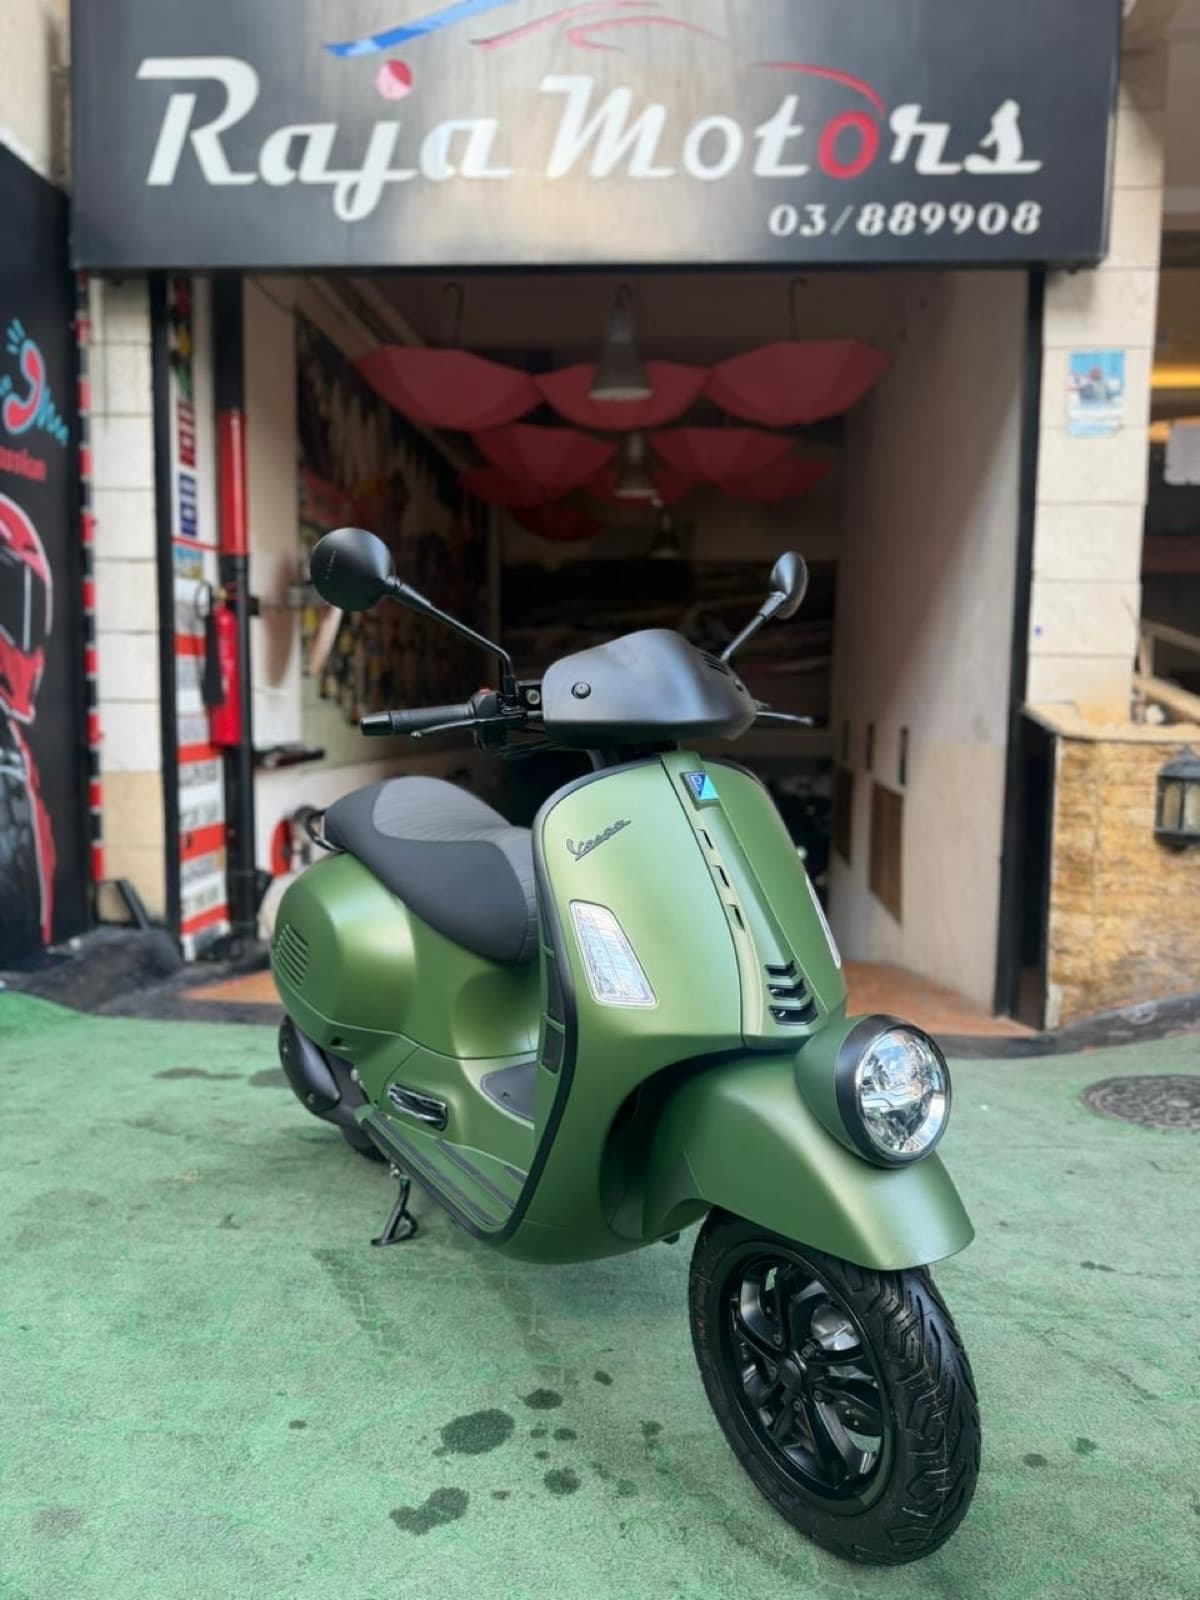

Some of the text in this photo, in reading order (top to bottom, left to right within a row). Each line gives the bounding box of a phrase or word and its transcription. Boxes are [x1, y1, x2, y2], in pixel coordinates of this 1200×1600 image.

[136, 56, 1042, 221] Raja Motors
[768, 201, 1042, 237] 03/889908
[566, 819, 632, 861] Vespa
